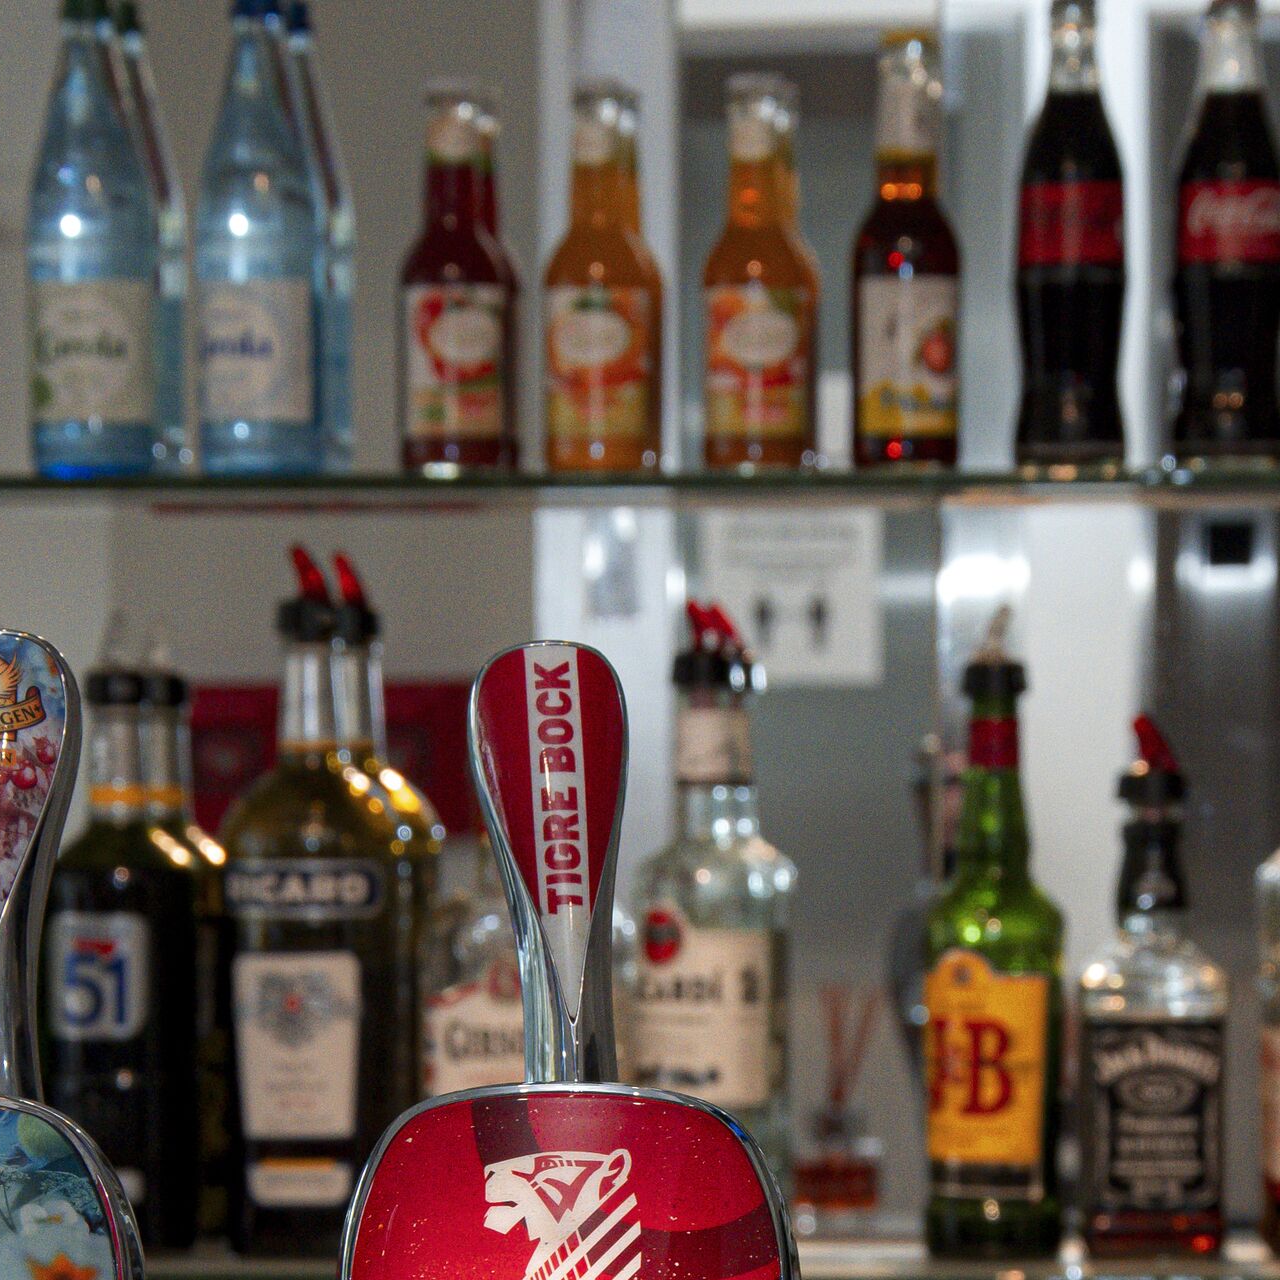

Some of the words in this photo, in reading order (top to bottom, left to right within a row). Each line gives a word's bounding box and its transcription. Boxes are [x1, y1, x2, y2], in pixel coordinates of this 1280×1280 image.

[534, 661, 577, 774] BOCK
[541, 786, 584, 916] TIGRE
[64, 952, 129, 1028] 51
